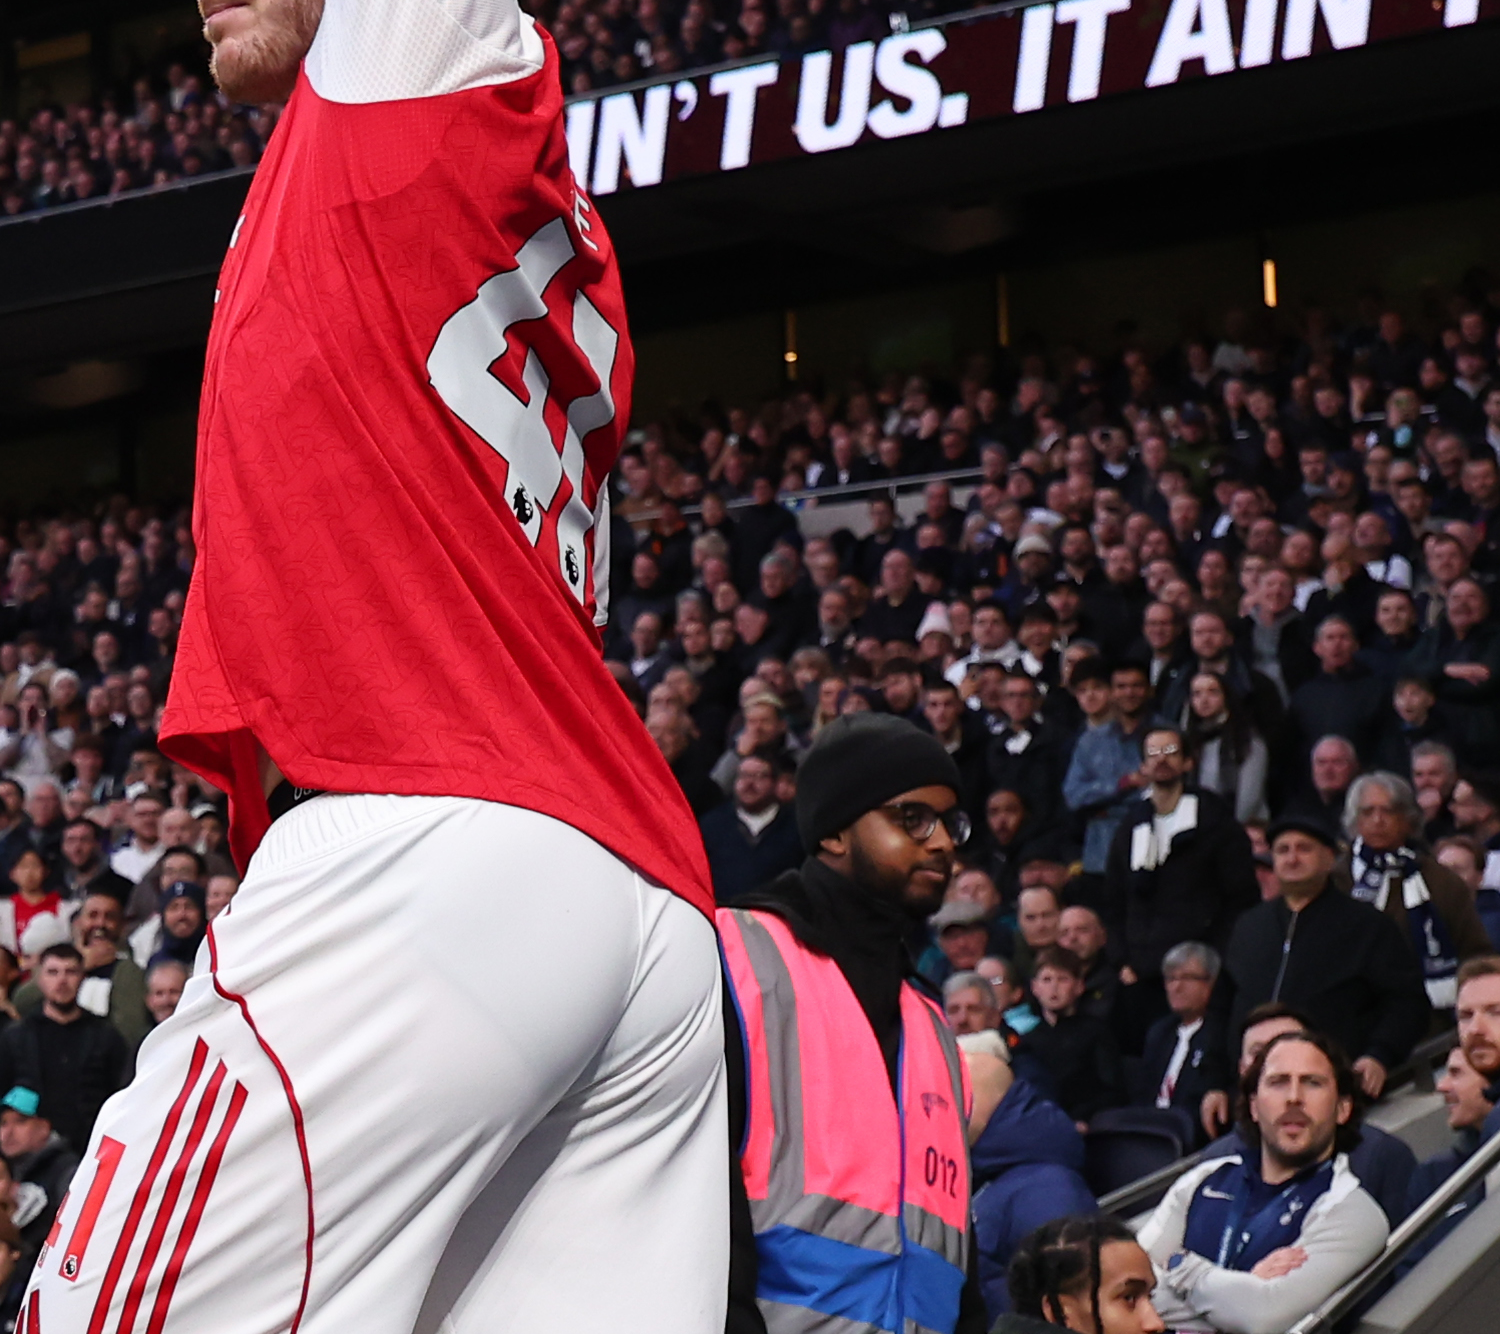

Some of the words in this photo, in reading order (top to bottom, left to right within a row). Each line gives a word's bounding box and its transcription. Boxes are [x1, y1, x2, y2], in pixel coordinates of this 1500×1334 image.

[566, 62, 779, 196] IN'T
[794, 29, 969, 153] US.
[38, 1134, 127, 1282] 1
